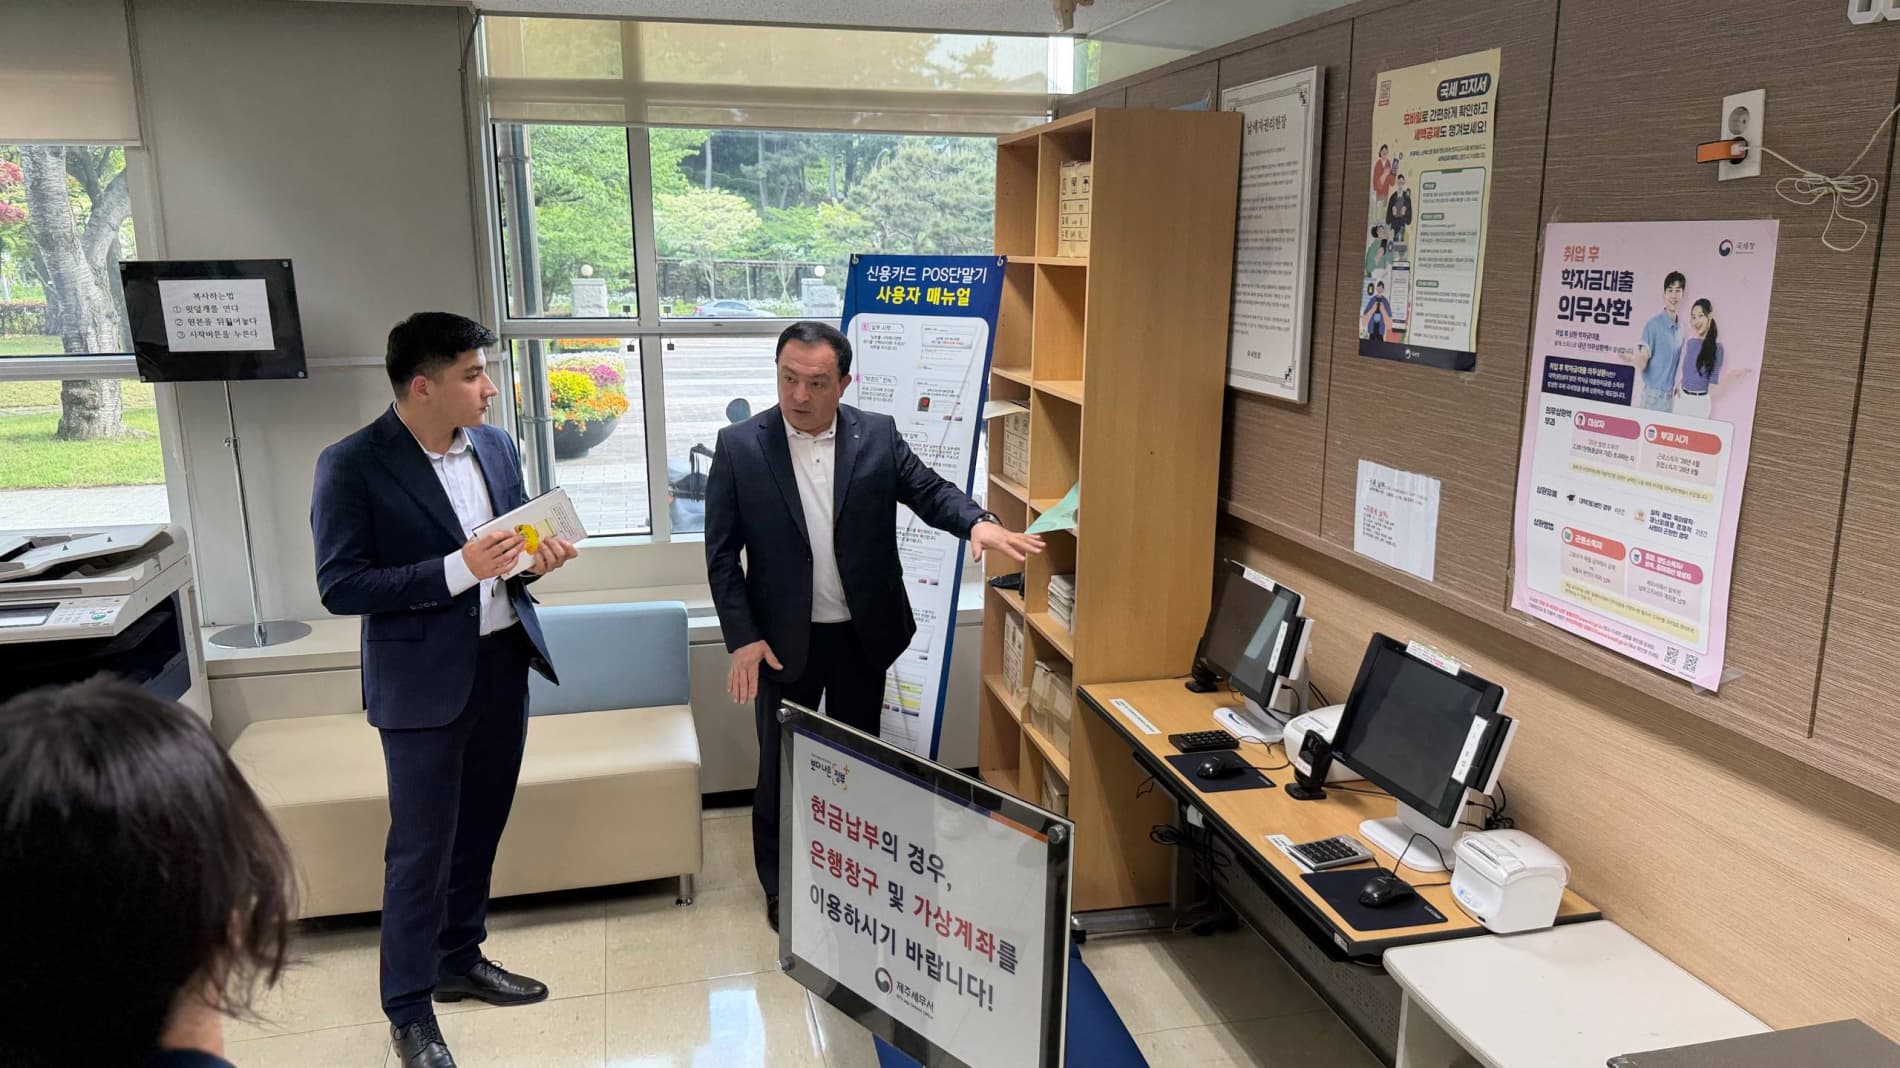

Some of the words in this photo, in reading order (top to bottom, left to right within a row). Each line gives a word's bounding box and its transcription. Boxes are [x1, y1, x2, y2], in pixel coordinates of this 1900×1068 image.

[1440, 81, 1457, 98] 국세
[1459, 75, 1488, 96] 고지서
[1403, 110, 1428, 126] 모바일로
[1429, 105, 1457, 122] 간편하게
[1459, 101, 1489, 118] 확인하고
[1448, 121, 1487, 137] 챙겨보세요!
[1563, 245, 1586, 262] 취업
[1588, 246, 1600, 263] 후
[866, 265, 917, 282] 신용카드
[922, 266, 987, 284] POS단말기
[1561, 268, 1634, 293] 학자금대출
[223, 304, 239, 313] 연다
[876, 285, 921, 305] 사용자
[926, 286, 971, 307] 매뉴얼
[1557, 295, 1632, 326] 의무상환
[811, 795, 898, 863] 현금납부의
[907, 842, 952, 892] 경우,
[810, 840, 879, 896] 은행창구
[888, 881, 904, 913] 및
[913, 894, 1019, 976] 가상계좌를
[810, 884, 896, 956] 이용하시기
[906, 937, 994, 1012] 바랍니다!
[897, 981, 934, 1013] 제주세무서
